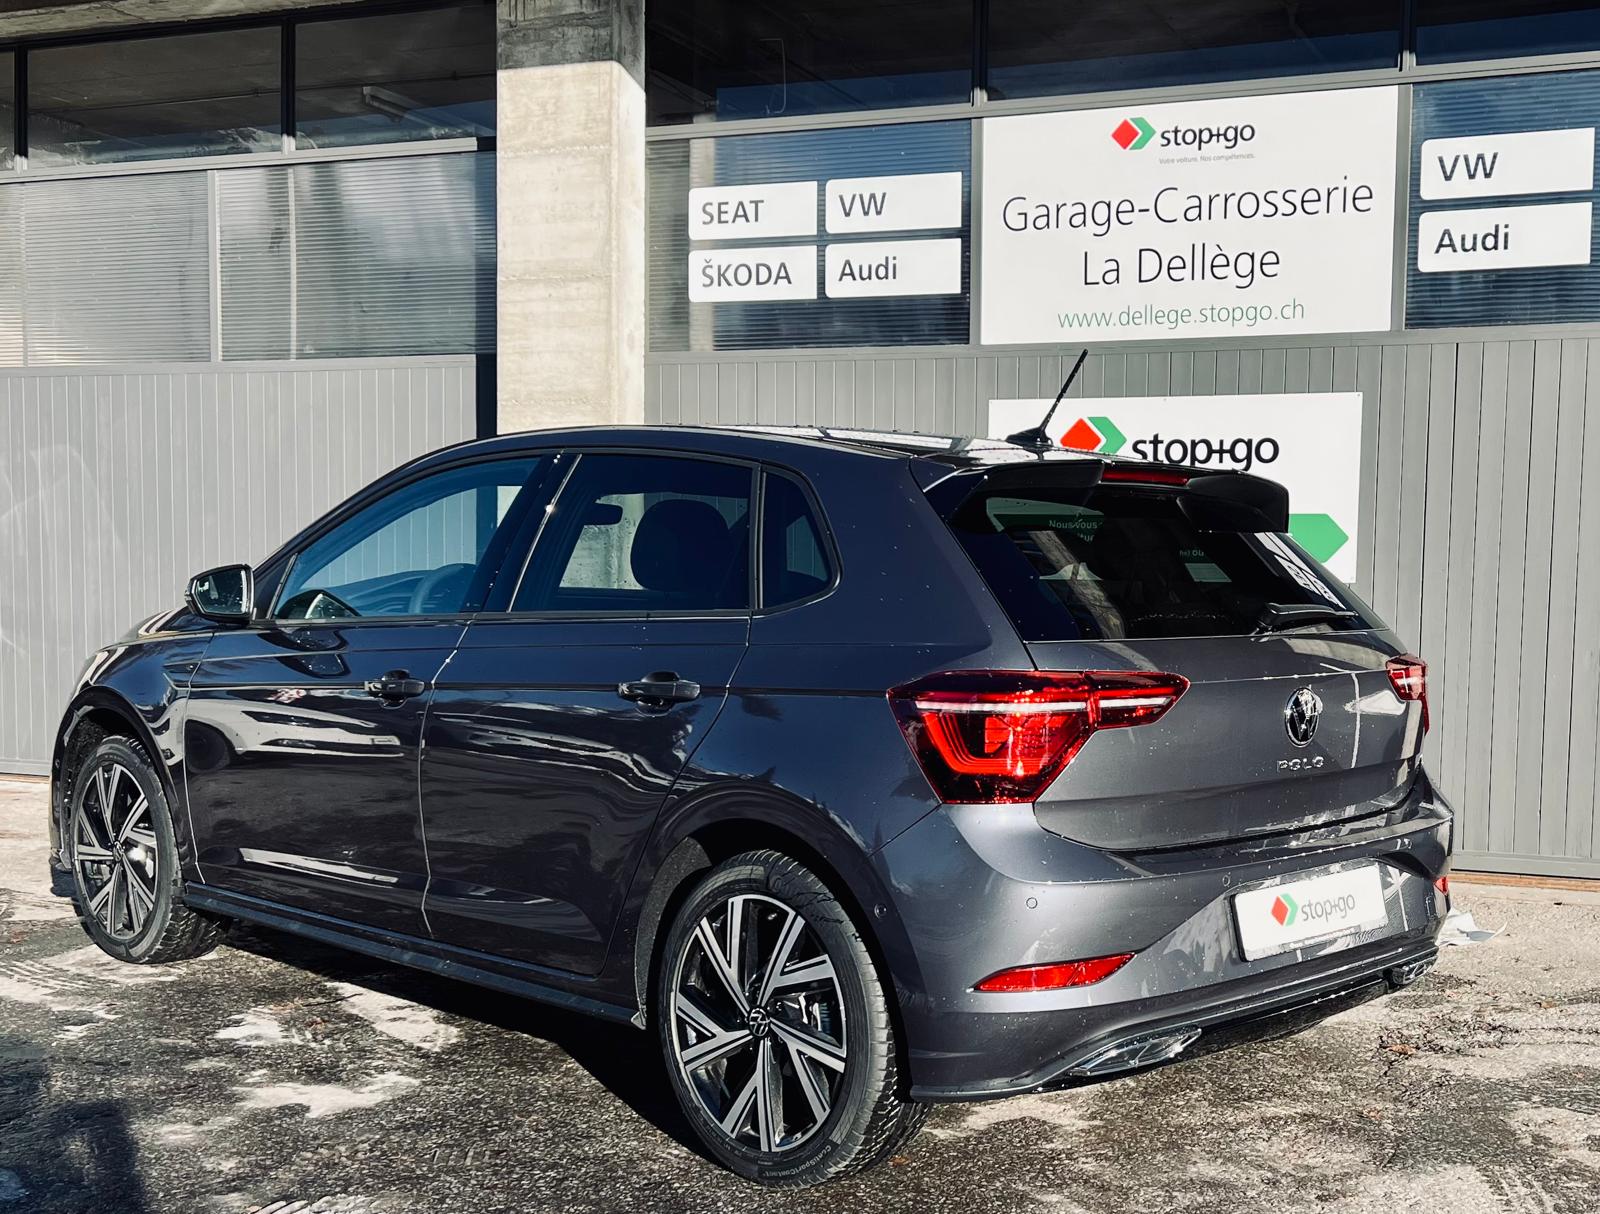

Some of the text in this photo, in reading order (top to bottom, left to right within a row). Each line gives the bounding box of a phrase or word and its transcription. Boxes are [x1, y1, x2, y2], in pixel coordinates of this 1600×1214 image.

[1160, 124, 1255, 151] stop+go
[1437, 151, 1499, 182] VW
[701, 199, 765, 226] SEAT
[838, 191, 887, 218] VW
[1002, 175, 1374, 237] Garage-Carrosserie
[1434, 223, 1510, 255] Audi
[701, 258, 793, 288] ŠKODA
[838, 256, 898, 282] Audi
[1083, 243, 1281, 289] La Dellège
[1057, 298, 1305, 330] www.dellege.stopgo.ch
[1131, 432, 1280, 472] stop+go
[1276, 756, 1325, 773] POLO
[1300, 893, 1356, 923] stop+go
